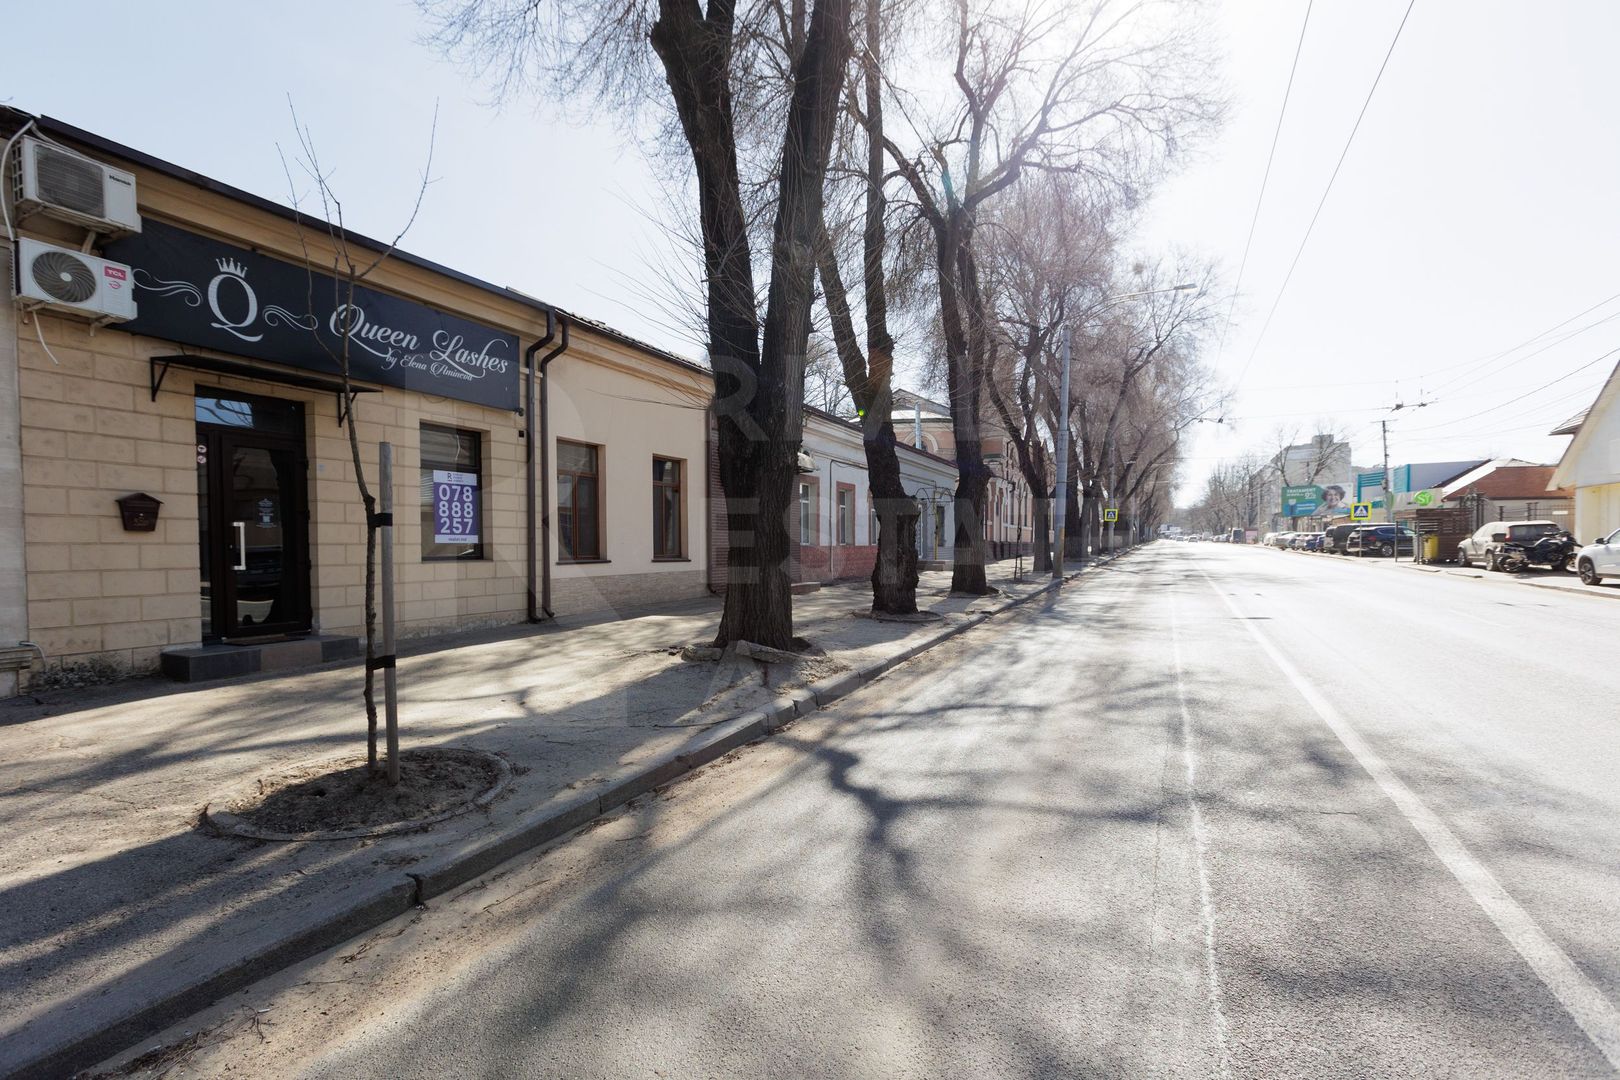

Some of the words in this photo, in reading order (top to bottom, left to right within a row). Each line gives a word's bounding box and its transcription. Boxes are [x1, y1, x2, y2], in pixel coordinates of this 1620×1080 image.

[106, 269, 124, 278] TCL
[329, 303, 420, 358] Queen
[429, 329, 509, 379] Lashes
[381, 347, 402, 370] by
[400, 354, 427, 371] Elena
[438, 484, 473, 502] 078
[438, 501, 474, 518] 888
[440, 517, 473, 534] 257
